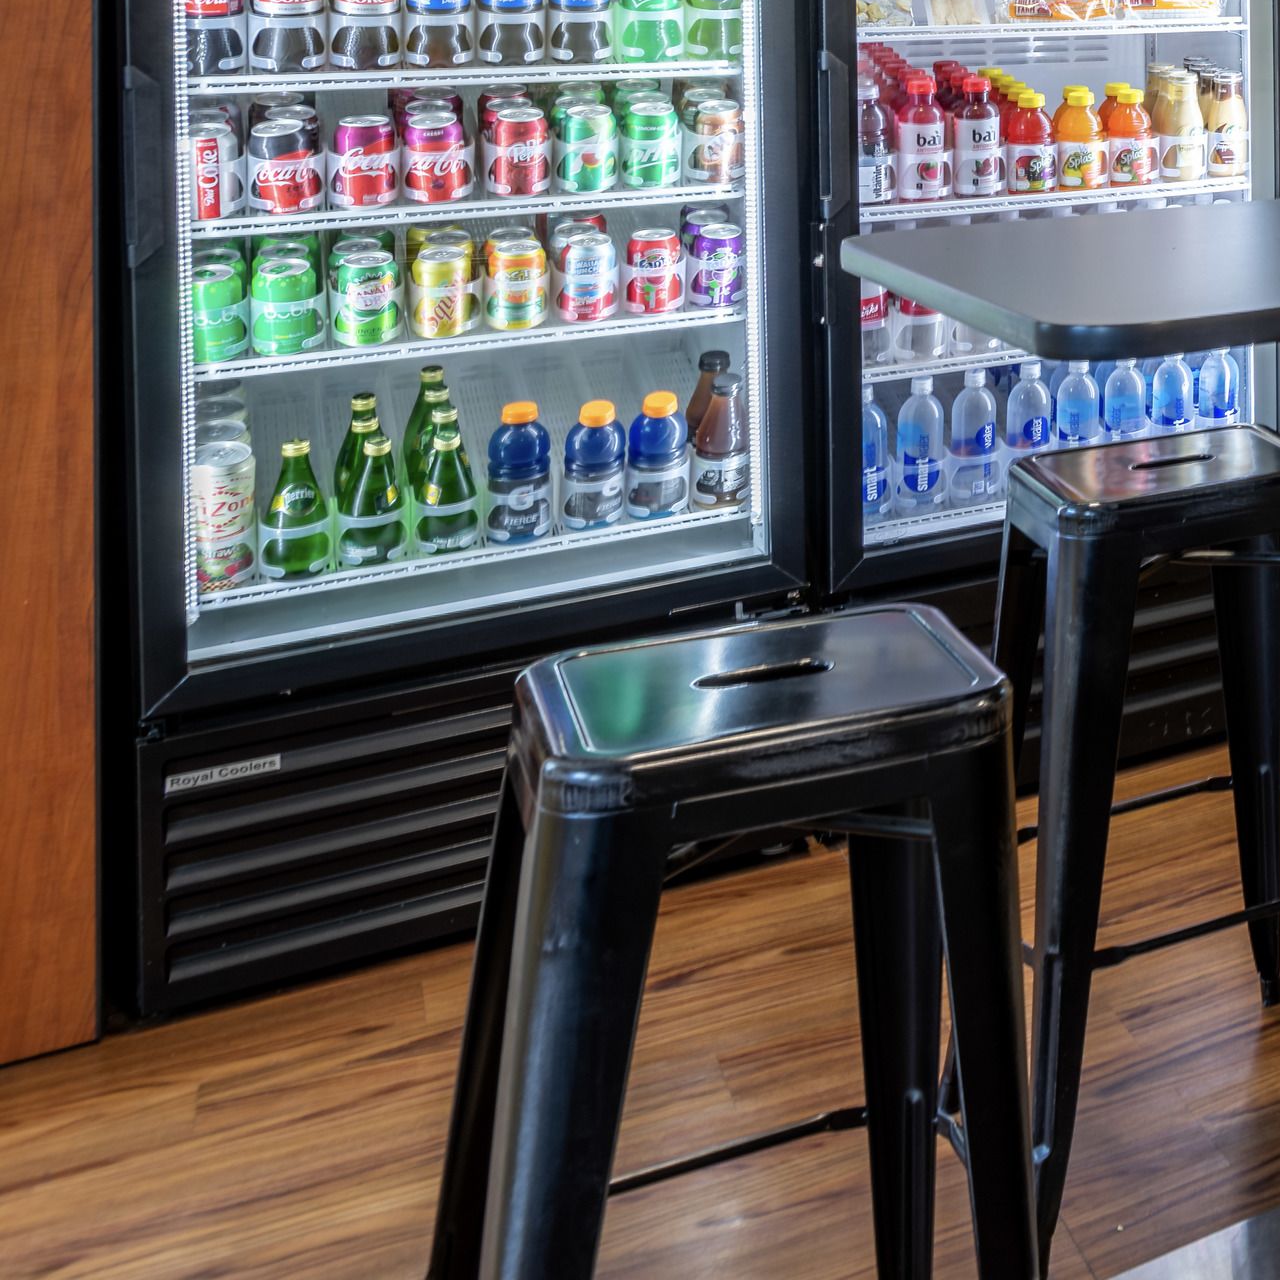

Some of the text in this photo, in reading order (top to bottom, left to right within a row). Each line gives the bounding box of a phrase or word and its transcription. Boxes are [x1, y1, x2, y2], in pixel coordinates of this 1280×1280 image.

[916, 132, 942, 147] bai
[972, 129, 996, 143] bai
[170, 759, 277, 788] Royal Coolers
